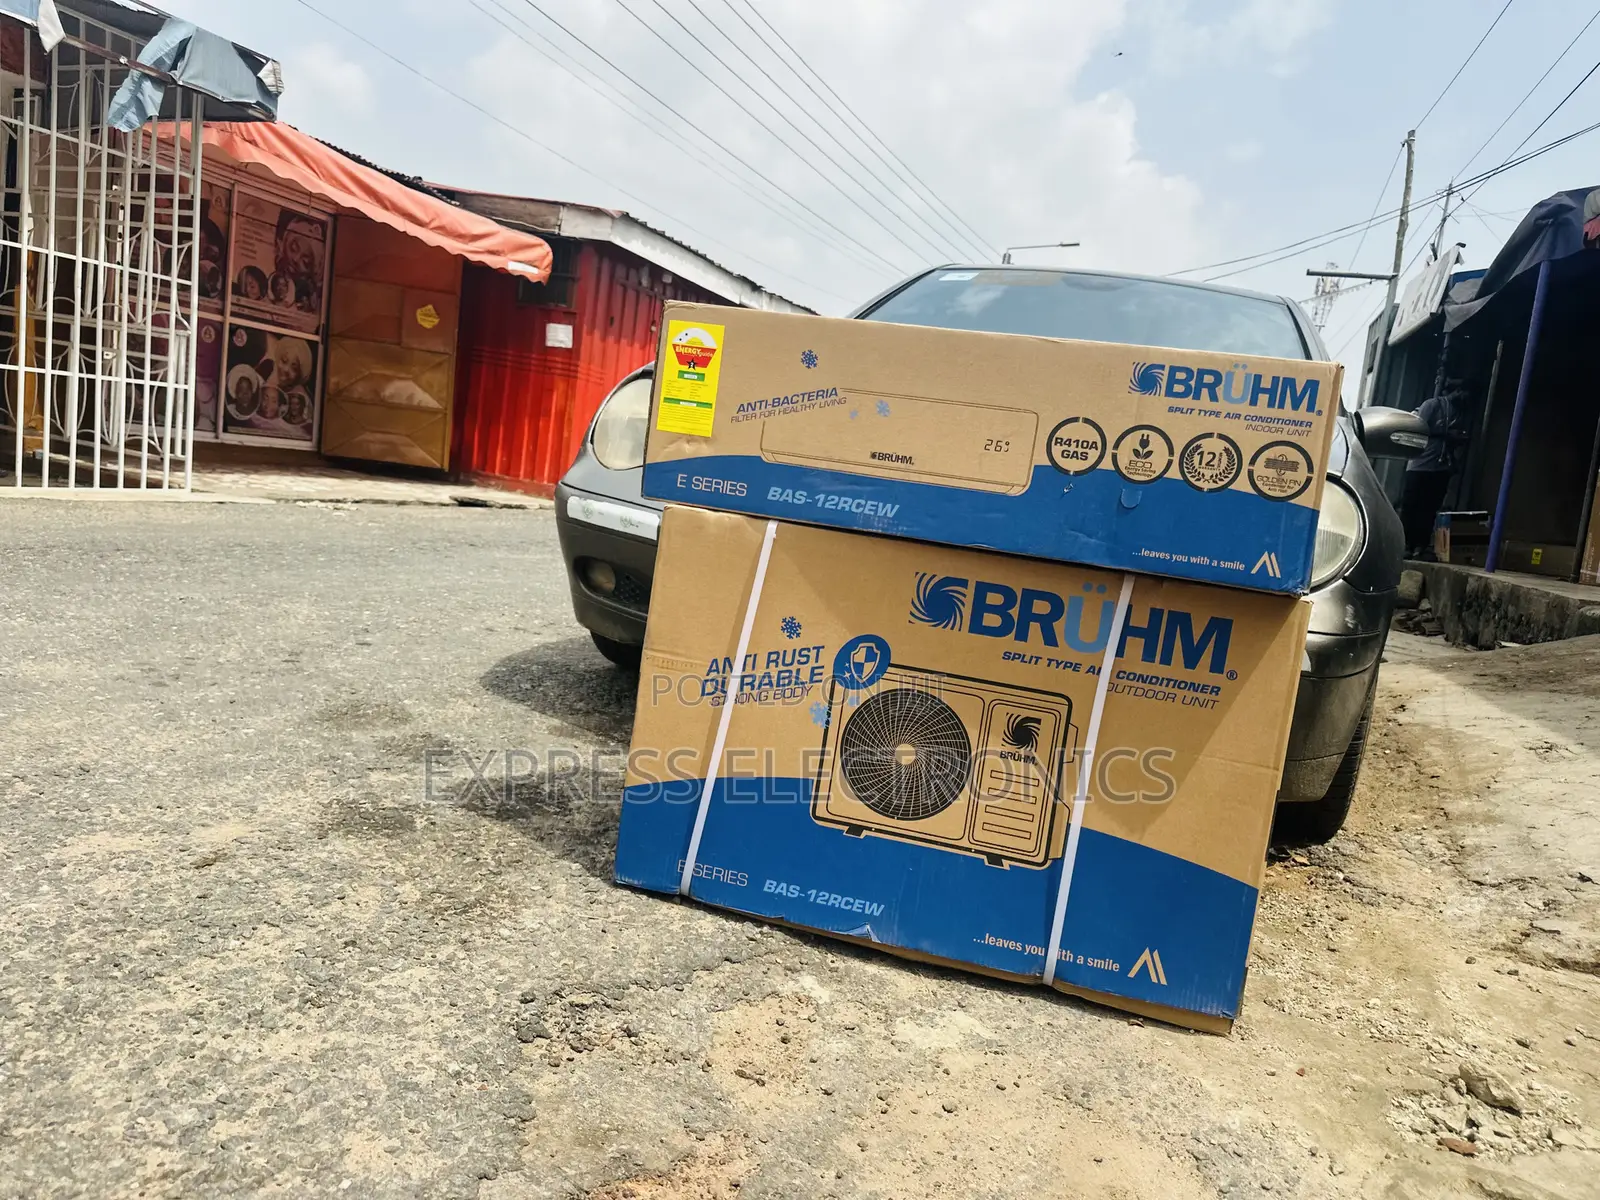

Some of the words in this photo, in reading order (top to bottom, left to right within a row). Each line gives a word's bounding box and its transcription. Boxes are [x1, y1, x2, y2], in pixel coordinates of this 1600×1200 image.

[736, 387, 838, 414] ANTI-BACTERIA
[1164, 362, 1321, 415] BRÜHM
[730, 413, 757, 424] FILTER
[759, 409, 776, 419] FOR
[778, 402, 817, 416] HEALTHY
[819, 396, 848, 409] LIVING
[1167, 405, 1195, 416] SPLIT
[1199, 408, 1222, 419] TYPE
[1224, 411, 1242, 421] AIR
[1244, 414, 1313, 429] CONDITIONER
[1245, 423, 1285, 436] INDOOR
[1287, 427, 1312, 438] UNIT
[1054, 436, 1099, 451] R410A
[1061, 449, 1089, 461] GAS
[877, 452, 912, 465] BRÜHM
[1128, 459, 1153, 470] ECO
[1196, 450, 1217, 468] 12
[677, 473, 687, 488] E
[691, 475, 748, 497] SERIES
[1256, 475, 1288, 485] GOLDEN
[766, 486, 900, 519] BAS-12RCEW
[1171, 553, 1188, 563] you
[1189, 555, 1210, 566] with
[1211, 559, 1218, 567] a
[1219, 560, 1246, 571] smile
[968, 580, 1234, 675] BRÜHM
[765, 645, 825, 670] RUST
[1002, 651, 1043, 666] SPLIT
[1046, 657, 1083, 673] TYPE
[1084, 665, 1104, 677] AI
[1115, 669, 1222, 697] CONDITIONER
[773, 685, 814, 700] BODY
[1106, 681, 1178, 704] OUTDOOR
[1181, 694, 1220, 710] UNIT
[1000, 750, 1036, 765] BRÜHM
[693, 862, 749, 887] SERIES
[763, 879, 885, 917] BAS-12RCEW
[1024, 943, 1045, 956] you
[1076, 954, 1084, 965] a
[1087, 957, 1121, 972] smile
